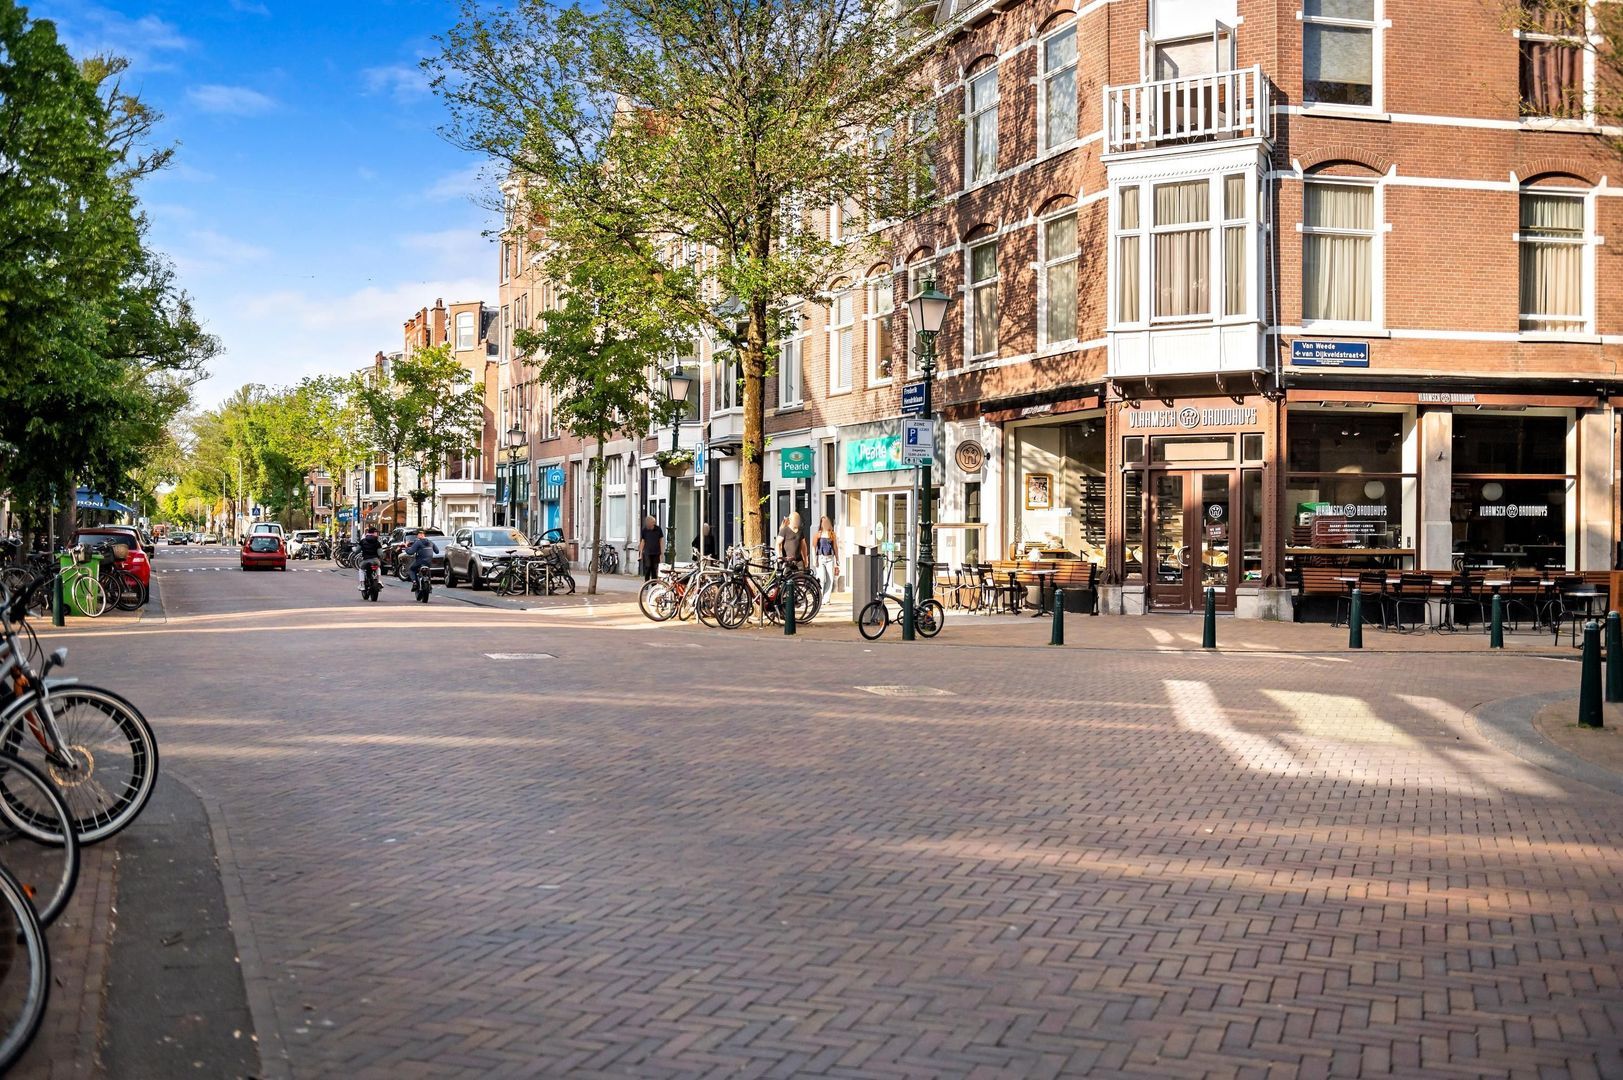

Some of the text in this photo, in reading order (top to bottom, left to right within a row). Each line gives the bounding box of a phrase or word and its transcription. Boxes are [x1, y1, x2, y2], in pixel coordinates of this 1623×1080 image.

[1130, 408, 1257, 428] VLAAMSCH BROODHUYS
[860, 443, 886, 460] Pearle
[785, 462, 809, 470] Pearle
[1316, 505, 1387, 516] VLAAMSCH BROODHUYS
[1480, 505, 1547, 516] VLAAMSCH BROODHUYS
